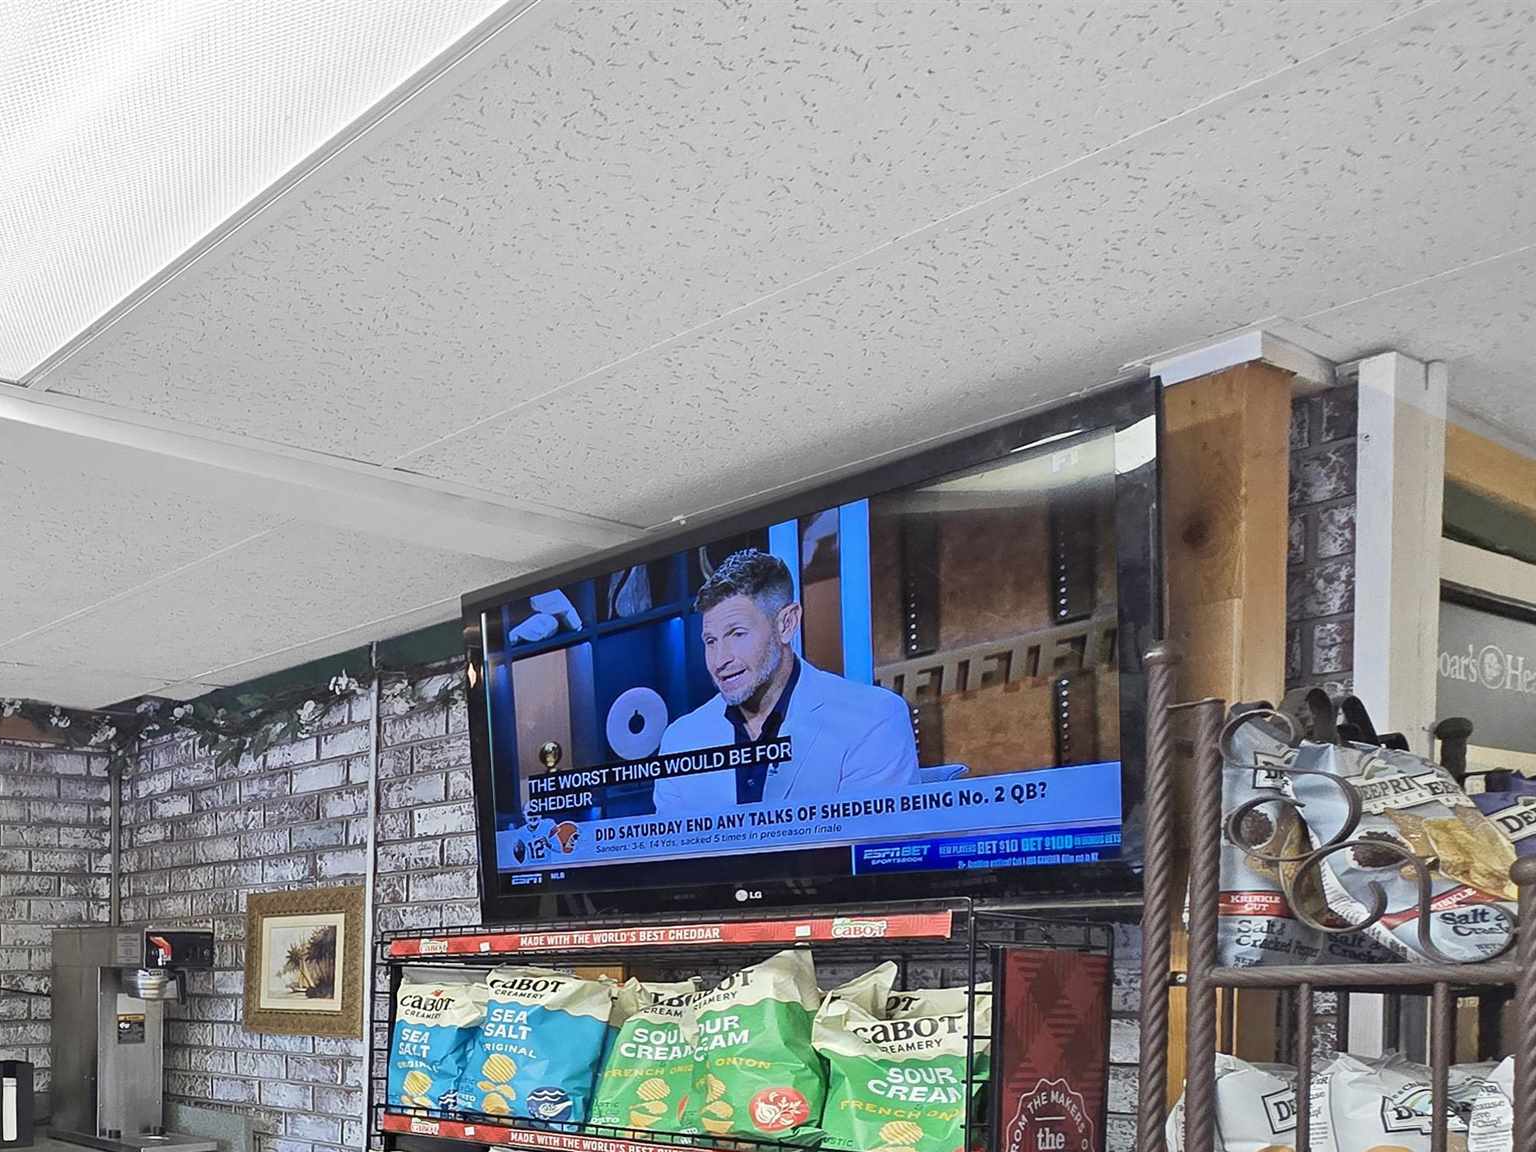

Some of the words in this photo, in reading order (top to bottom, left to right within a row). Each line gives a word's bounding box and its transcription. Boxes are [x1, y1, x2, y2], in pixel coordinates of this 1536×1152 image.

[529, 778, 556, 795] THE
[558, 769, 609, 790] WORST
[612, 762, 661, 782] THING
[664, 752, 724, 774] WOULD
[729, 750, 752, 766] BE
[755, 742, 791, 763] FOR
[529, 792, 593, 813] SHEDEUR
[595, 827, 615, 842] DID
[619, 820, 683, 839] SATURDAY
[686, 817, 713, 832] END
[716, 813, 745, 830] ANY
[749, 809, 793, 826] TALKS
[797, 806, 817, 821] OF
[821, 796, 895, 819] SHEDEUR
[901, 791, 953, 811] BEING
[958, 790, 989, 806] No.
[994, 786, 1005, 802] 2
[1010, 781, 1047, 802] QB?
[680, 833, 712, 846] sacked
[722, 830, 747, 842] times
[750, 829, 758, 839] in
[760, 826, 812, 843] preseason
[814, 823, 842, 836] finale
[977, 840, 997, 855] BET
[999, 840, 1018, 854] $10
[1044, 834, 1072, 850] $100
[511, 873, 542, 885] ESPN
[749, 891, 762, 900] LG
[1440, 909, 1488, 926] Salt
[520, 934, 545, 946] MADE
[547, 933, 570, 946] WITH
[573, 933, 590, 945] THE
[593, 930, 636, 944] WORLD'S
[639, 929, 664, 942] BEST
[668, 927, 720, 941] CHEDDAR
[494, 988, 544, 1001] CREAMERY
[490, 1008, 529, 1026] SEA
[400, 1028, 430, 1043] SEA
[484, 1023, 532, 1041] SALT
[398, 1042, 430, 1058] SALT
[715, 1057, 772, 1070] ONION
[885, 1067, 958, 1085] SOUR
[839, 1099, 921, 1121] FRENCH
[1027, 1091, 1048, 1114] THE
[1050, 1090, 1086, 1133] MAKERS
[510, 1130, 534, 1145] MADE
[536, 1133, 561, 1148] WITH
[562, 1135, 580, 1150] THE
[1036, 1127, 1065, 1150] the
